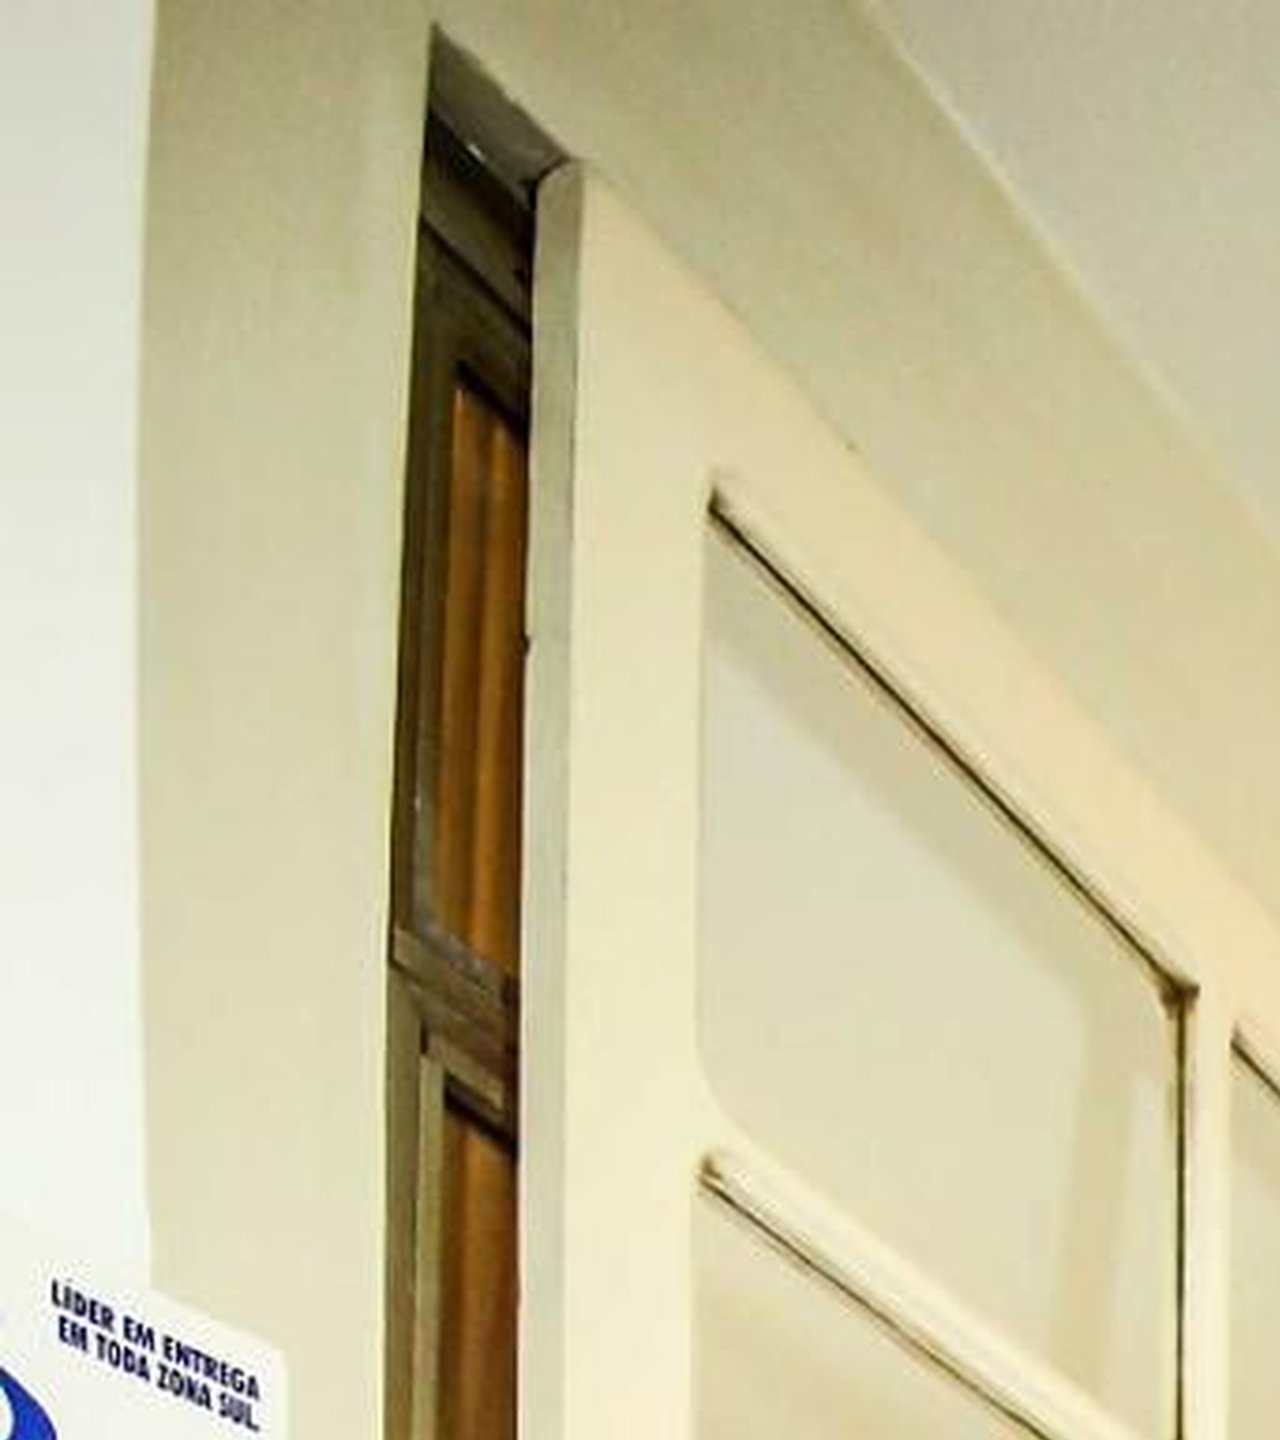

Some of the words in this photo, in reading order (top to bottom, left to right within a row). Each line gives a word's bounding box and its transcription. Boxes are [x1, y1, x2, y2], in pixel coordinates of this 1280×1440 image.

[58, 1315, 88, 1352] EM
[96, 1333, 150, 1381] TODA
[157, 1363, 212, 1411] ZONA
[123, 1315, 155, 1352] EM
[163, 1335, 260, 1401] ENTREGA
